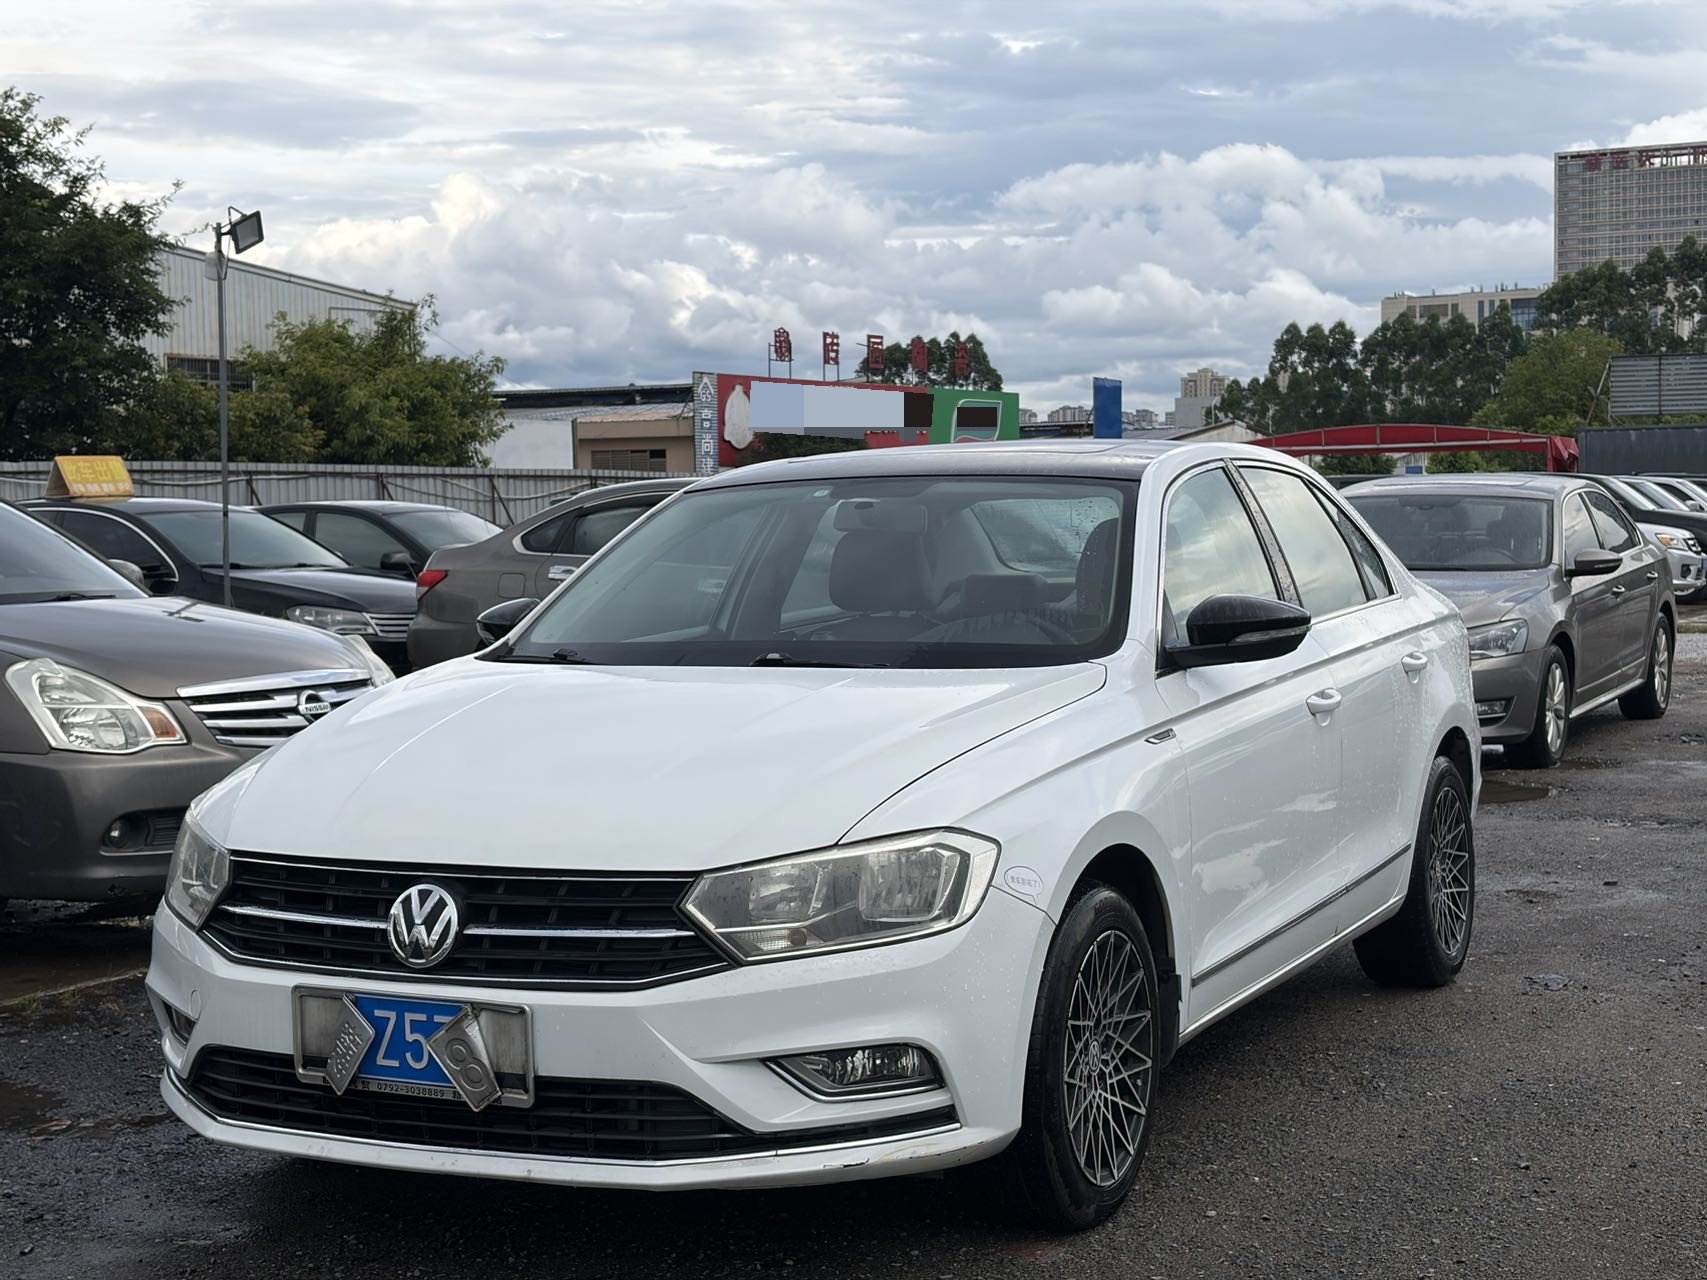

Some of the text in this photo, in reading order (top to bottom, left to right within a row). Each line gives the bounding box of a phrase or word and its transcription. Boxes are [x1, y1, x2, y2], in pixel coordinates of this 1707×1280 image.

[304, 702, 329, 712] NISSAN
[373, 1009, 455, 1070] Z5
[377, 1081, 445, 1098] 0792-3038889
